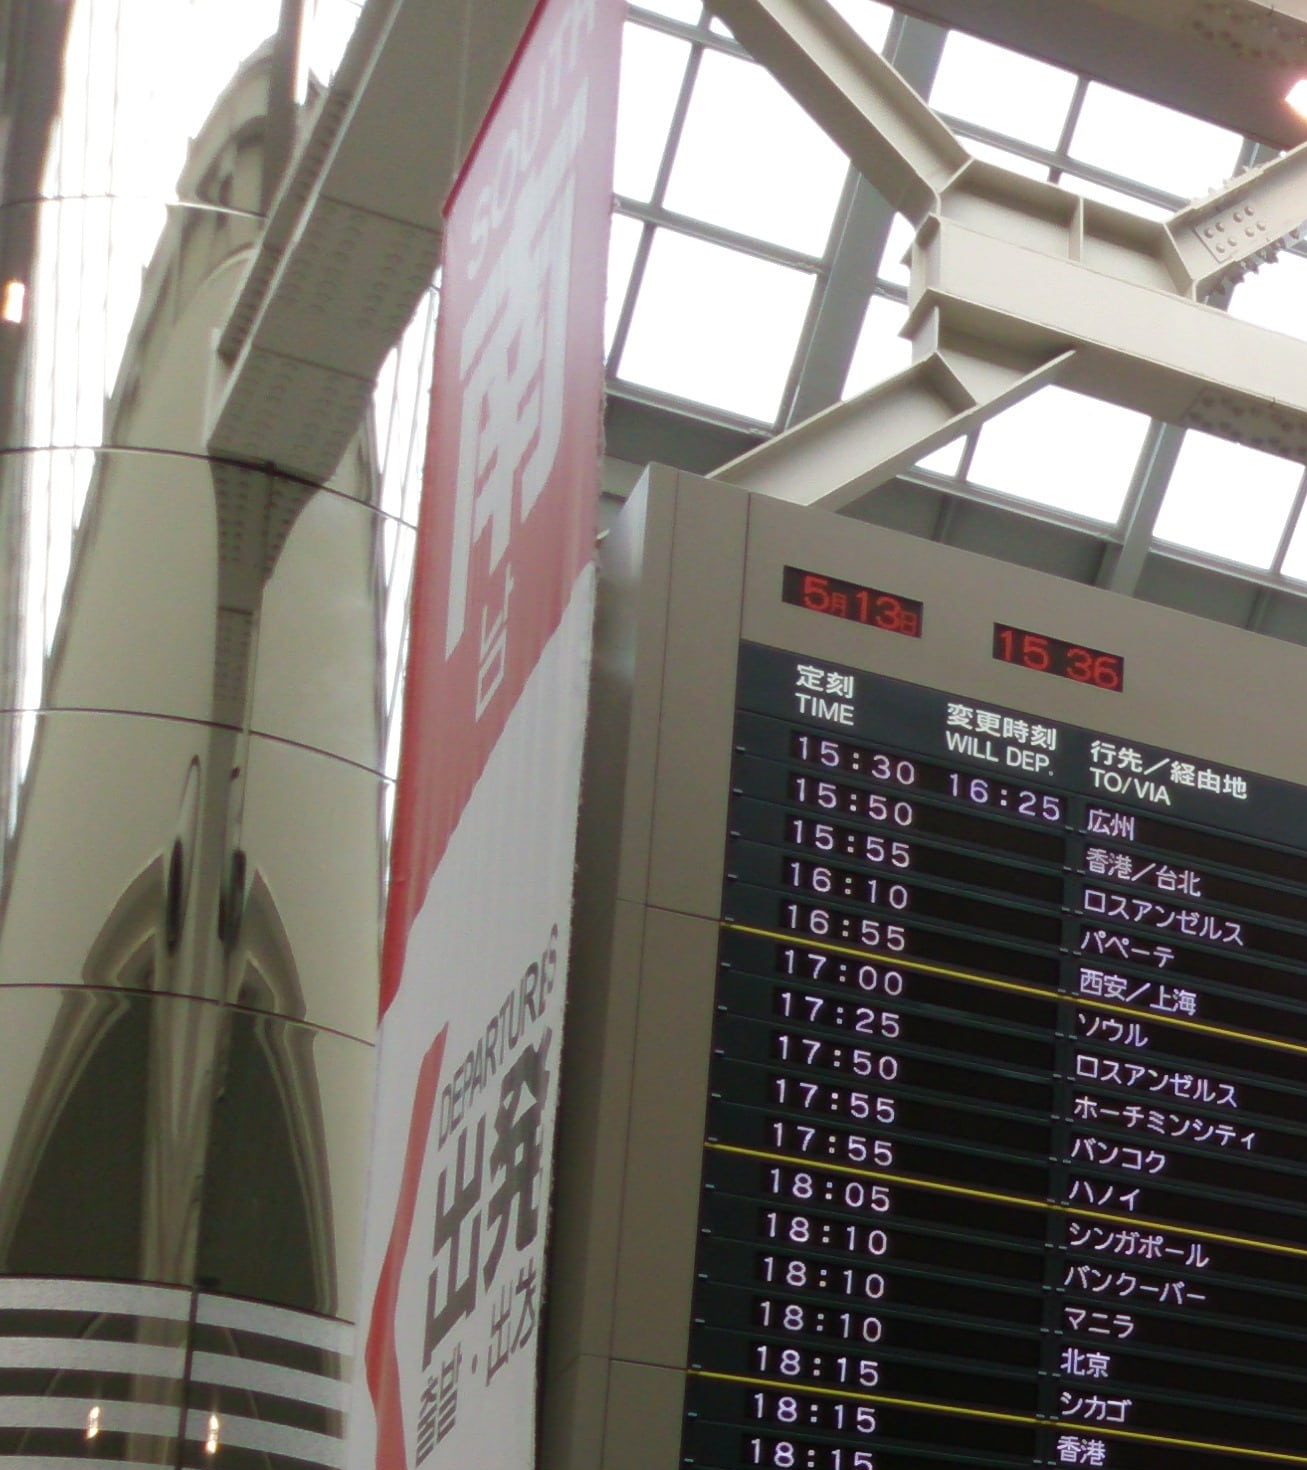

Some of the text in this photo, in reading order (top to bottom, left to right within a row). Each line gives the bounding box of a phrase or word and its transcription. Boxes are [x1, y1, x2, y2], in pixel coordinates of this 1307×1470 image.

[801, 574, 920, 638] 5月13日
[793, 691, 856, 727] TIME
[944, 729, 1000, 764] WILL
[1005, 745, 1054, 777] DEP.
[1088, 765, 1173, 807] TO/VIA
[794, 663, 856, 700] 定刻
[946, 701, 1058, 752] 変更時刻
[795, 777, 914, 827] 15:50
[798, 735, 916, 786] 15:30
[949, 772, 1061, 822] 16:25
[1085, 807, 1136, 843] 広州
[788, 903, 906, 953] 16:55
[789, 861, 909, 911] 16:10
[1079, 929, 1176, 969] パペーテ
[792, 819, 911, 869] 15:55
[1083, 888, 1245, 947] ロスアンゼルス
[436, 921, 559, 1152] DEPARTURES
[780, 991, 900, 1039] 17:25
[784, 948, 1150, 1049] 17:00 ソウル
[774, 1077, 1167, 1175] 17:55 バンコク
[777, 1034, 899, 1082] 17:50
[1072, 1095, 1257, 1151] ホーチミンシティ
[421, 1025, 554, 1373] 出発
[772, 1121, 1141, 1212] 17:55 ハノイ
[766, 1211, 1207, 1306] 18:10 バンクーバー
[769, 1167, 891, 1214] 18:05
[1068, 1221, 1211, 1269] シンガポール
[759, 1300, 883, 1344] 18:10
[1059, 1346, 1112, 1380] 北京
[1063, 1306, 1136, 1340] マニラ
[752, 1391, 1107, 1467] 18:15 香港
[755, 1344, 880, 1388] 18:15
[1059, 1390, 1133, 1424] シカゴ
